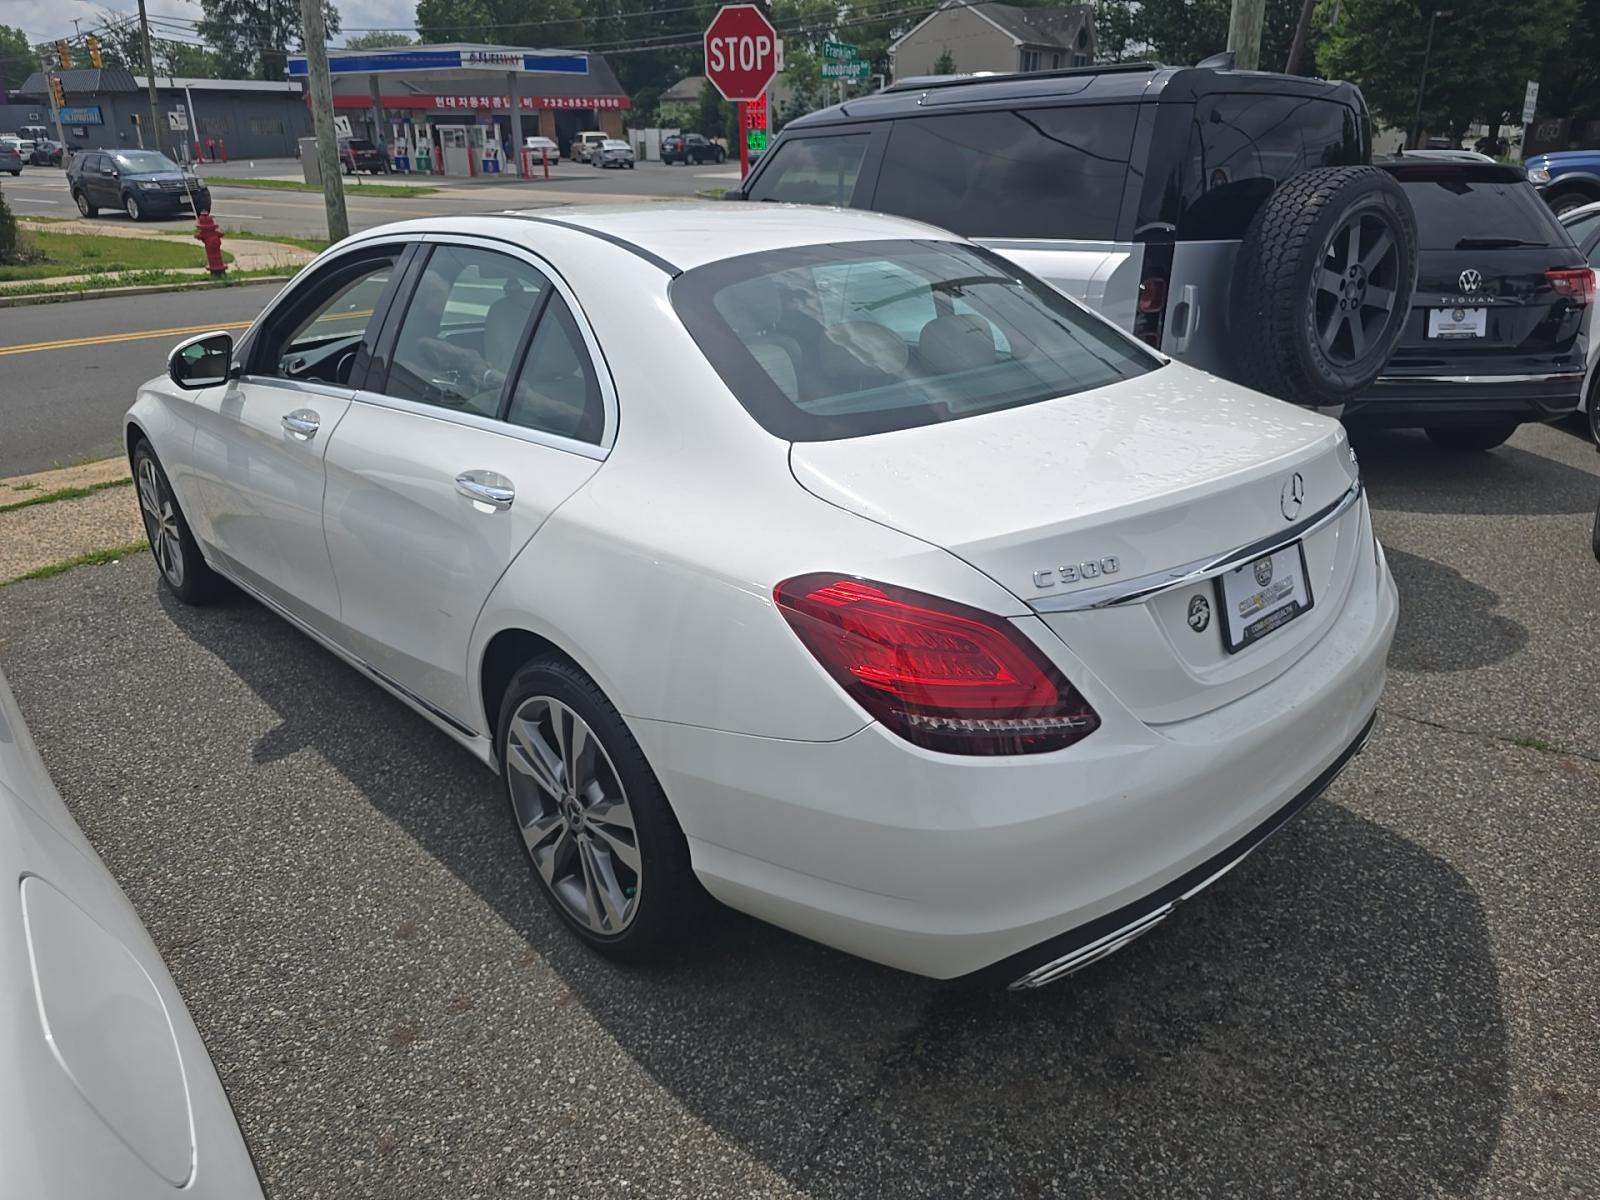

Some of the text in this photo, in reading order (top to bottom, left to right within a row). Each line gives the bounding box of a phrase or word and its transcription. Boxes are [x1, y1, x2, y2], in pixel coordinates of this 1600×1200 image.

[710, 35, 771, 73] STOP
[1032, 556, 1120, 589] C 300
